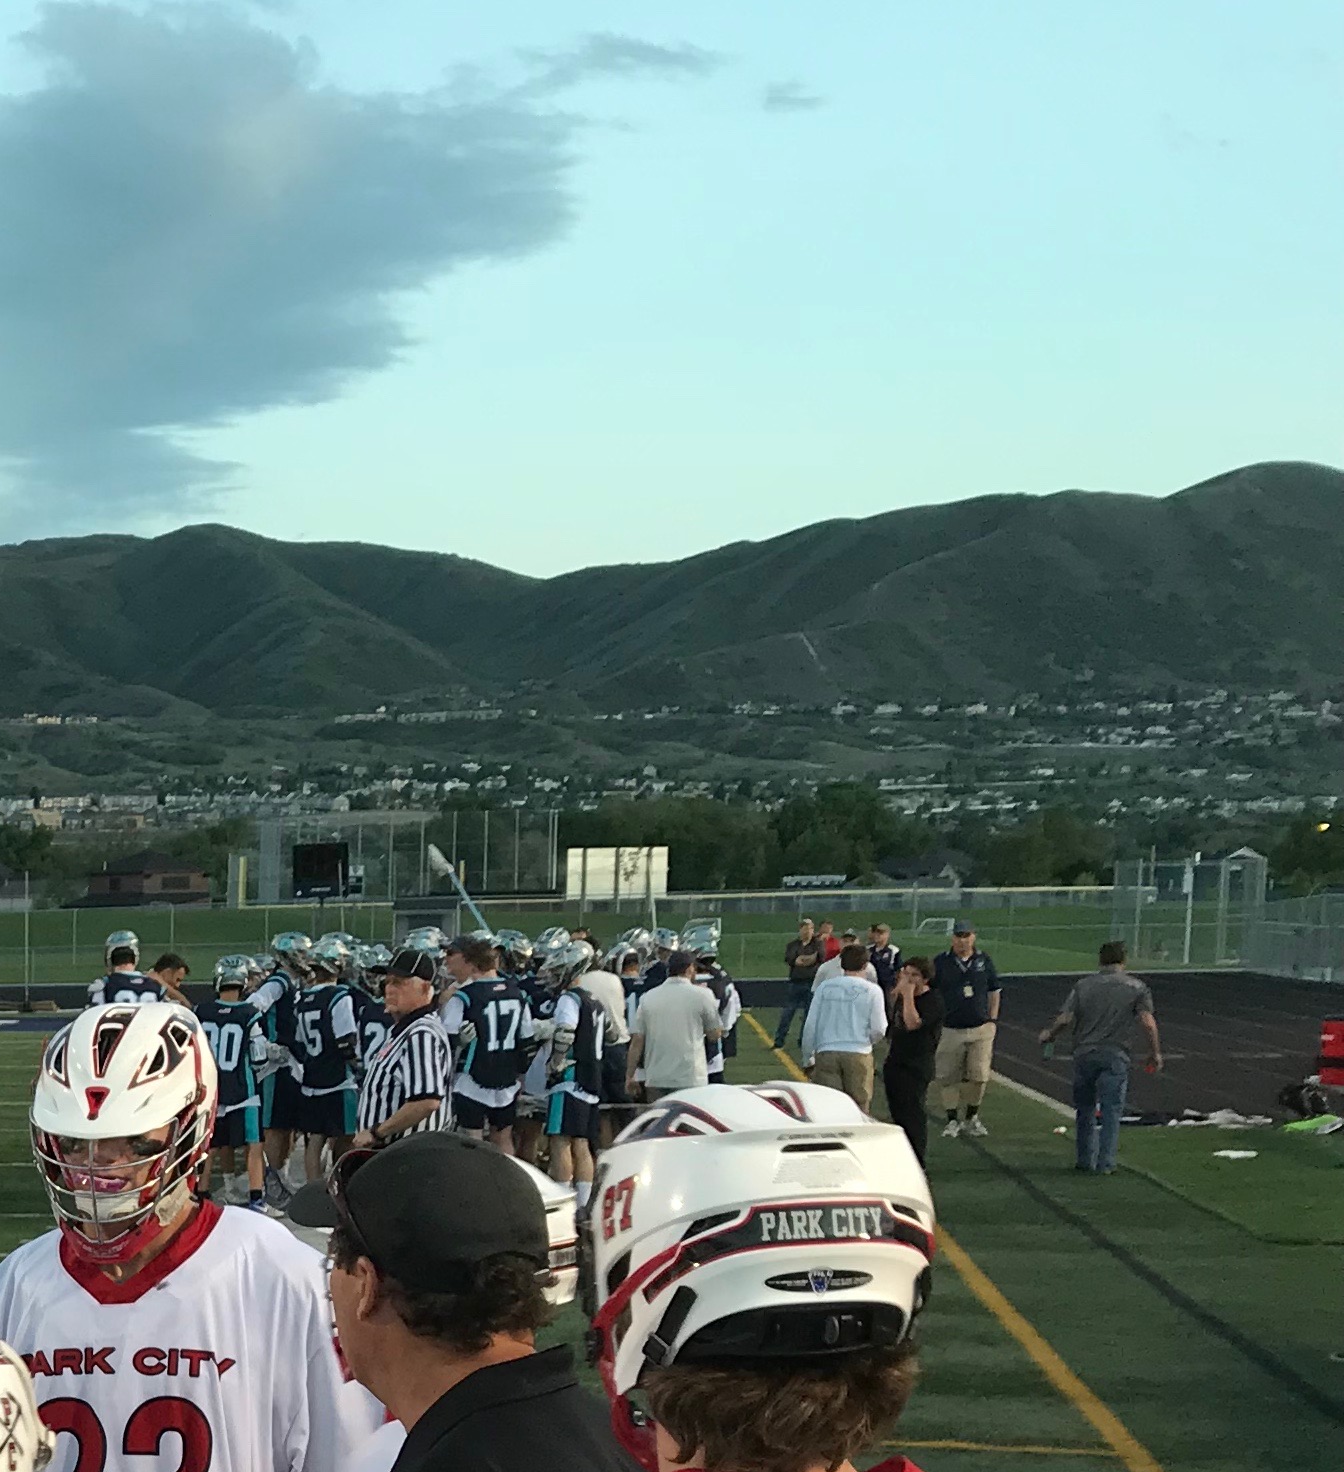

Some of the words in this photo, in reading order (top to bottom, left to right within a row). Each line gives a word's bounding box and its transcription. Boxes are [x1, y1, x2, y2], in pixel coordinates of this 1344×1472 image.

[483, 1000, 521, 1051] 17
[759, 1210, 826, 1242] PARK
[831, 1206, 884, 1240] CITY
